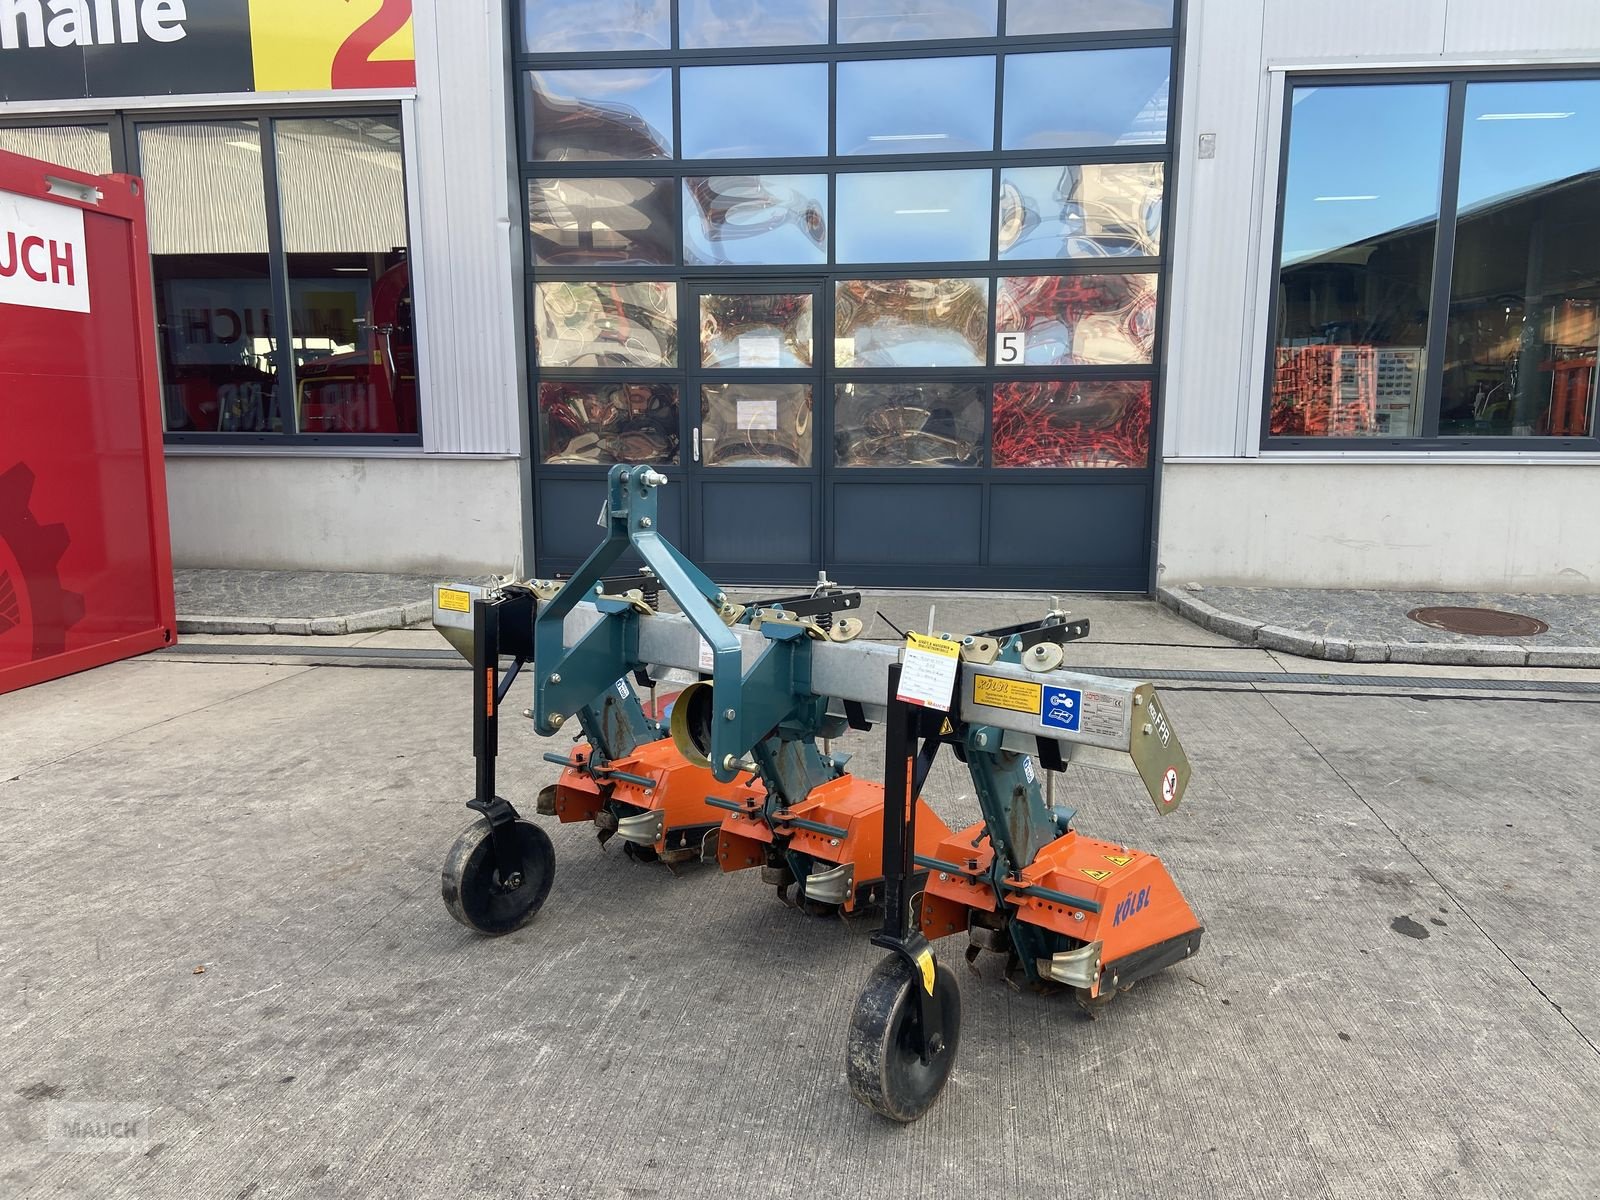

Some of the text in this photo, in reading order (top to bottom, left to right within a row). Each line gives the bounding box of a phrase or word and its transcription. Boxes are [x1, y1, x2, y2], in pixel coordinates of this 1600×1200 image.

[331, 0, 417, 89] 2
[1001, 336, 1018, 362] 5
[1112, 884, 1152, 928] KÖLBL
